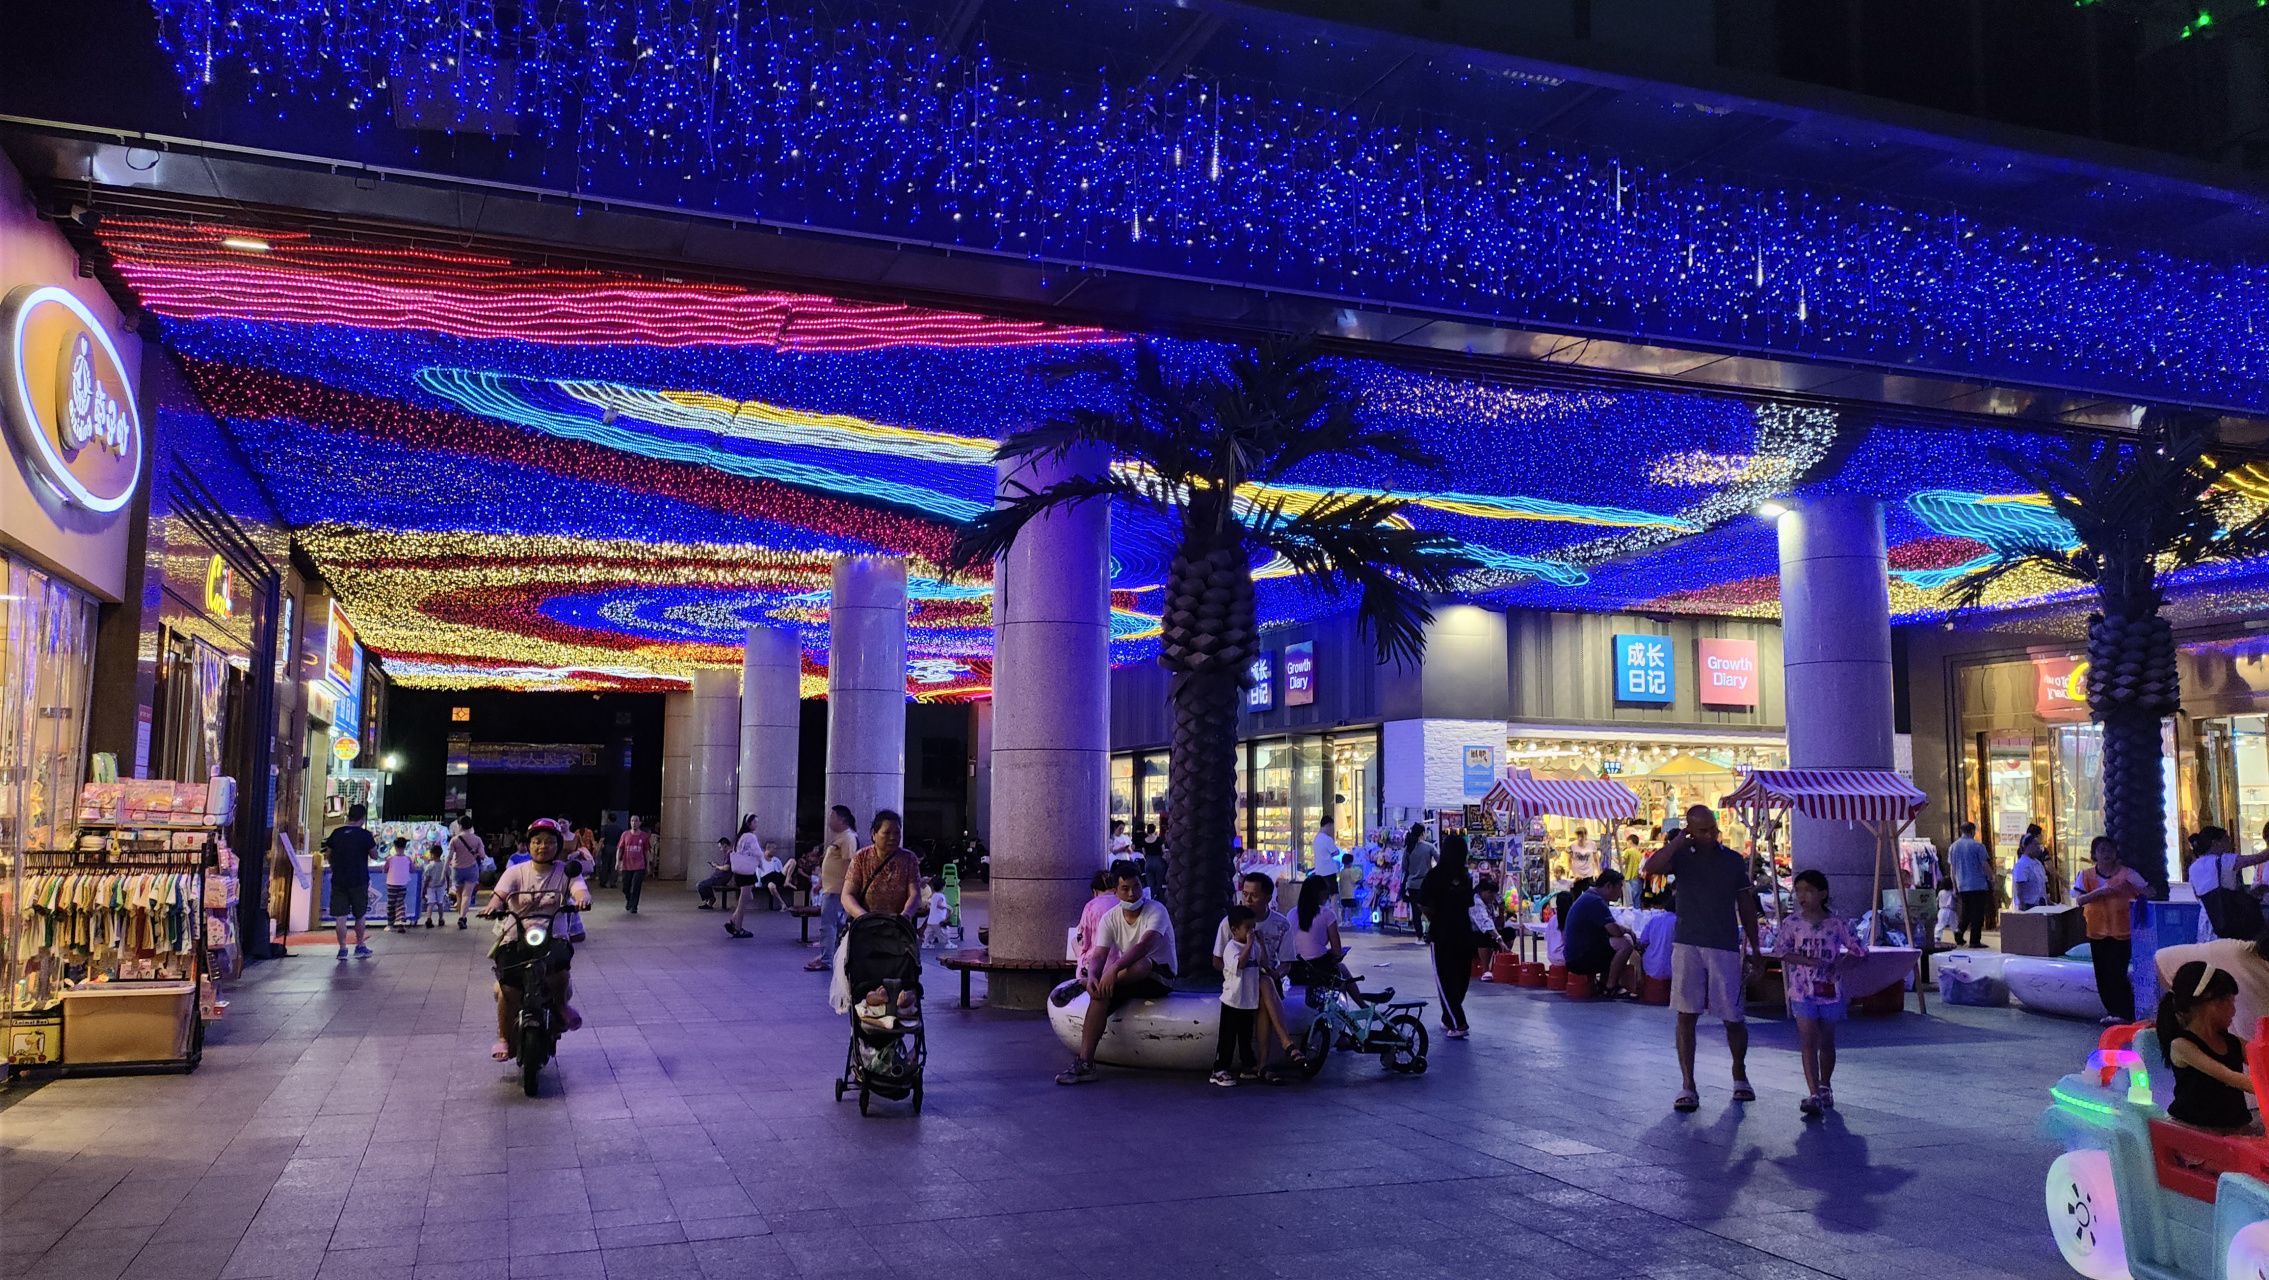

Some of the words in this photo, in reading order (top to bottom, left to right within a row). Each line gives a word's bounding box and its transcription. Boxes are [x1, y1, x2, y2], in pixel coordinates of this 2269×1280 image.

[1627, 642, 1665, 667] 成长
[1287, 658, 1311, 675] Growth
[1707, 656, 1752, 671] Growth
[1289, 676, 1308, 690] Diary
[1629, 669, 1666, 694] 日记
[1713, 672, 1748, 689] Diary
[1250, 683, 1268, 705] 日记
